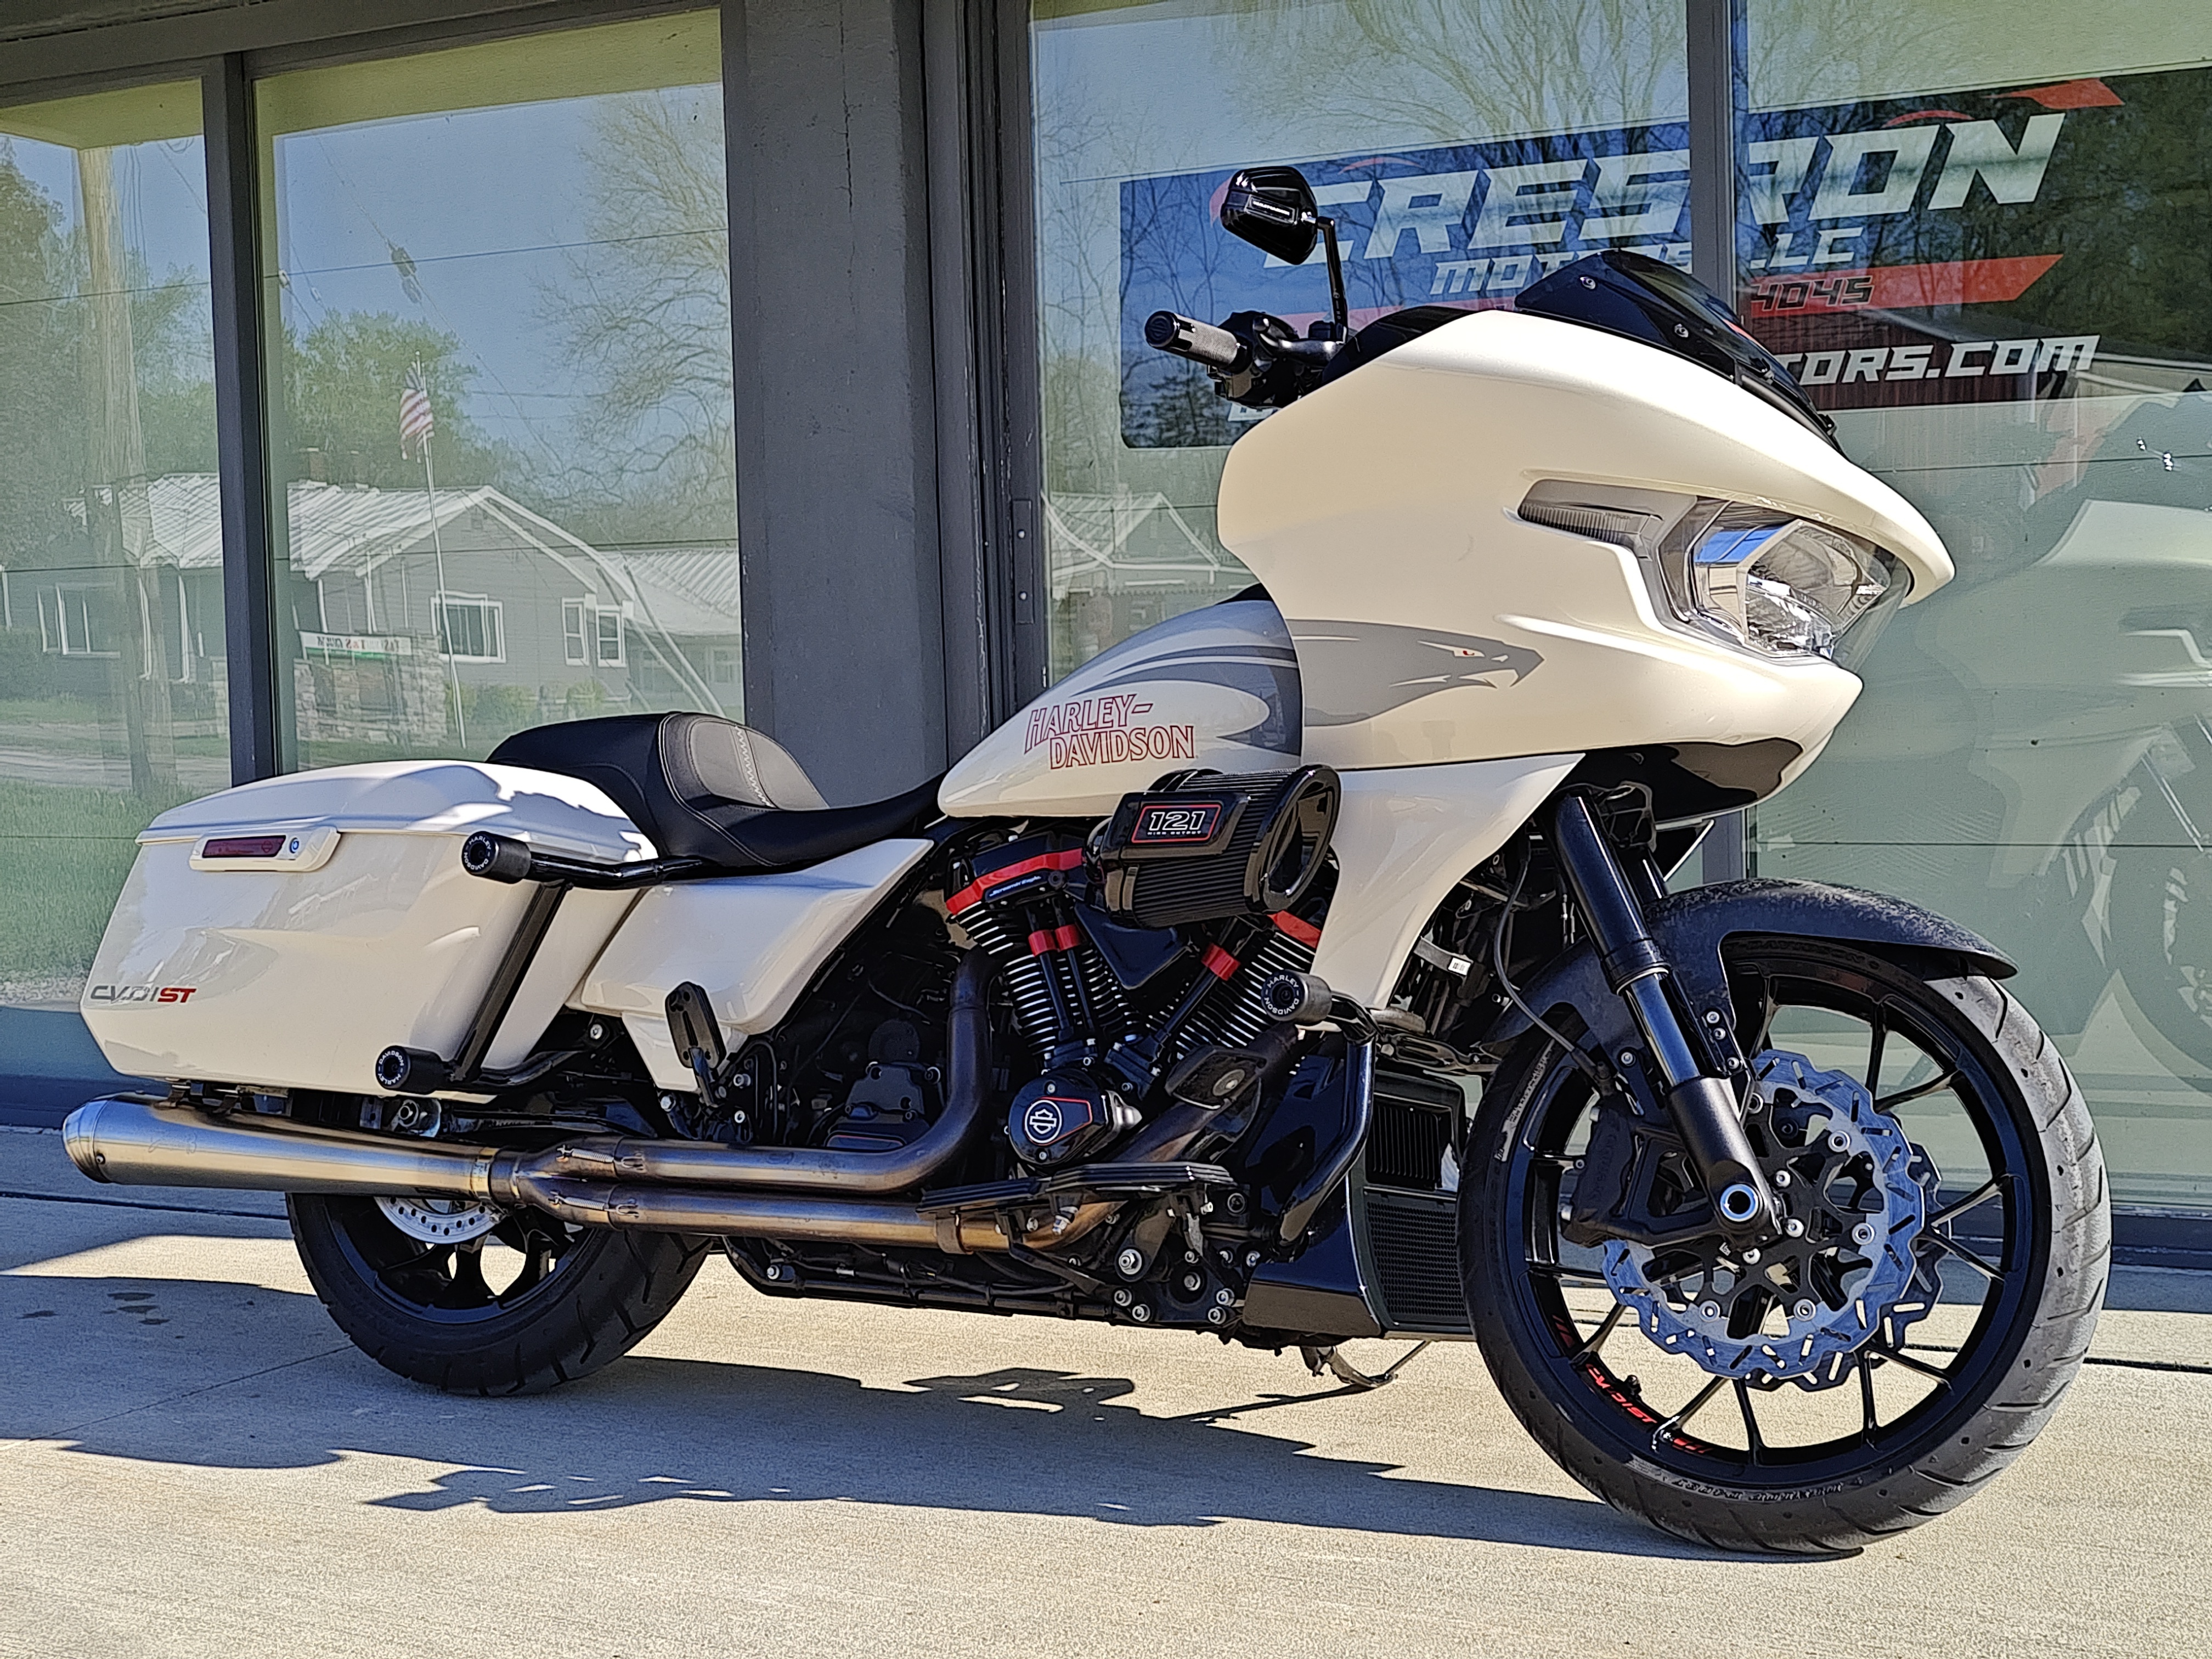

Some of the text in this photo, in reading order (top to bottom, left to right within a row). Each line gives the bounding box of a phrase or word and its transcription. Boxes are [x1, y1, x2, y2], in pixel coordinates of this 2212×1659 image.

[1049, 725, 1195, 769] DAVIDSON
[1149, 811, 1205, 831] 121
[464, 835, 492, 870] HARLEY DAVIDSON
[1264, 974, 1300, 1015] HARLEY DAVIDSON
[377, 1050, 404, 1085] DAVIDSON HARLEY
